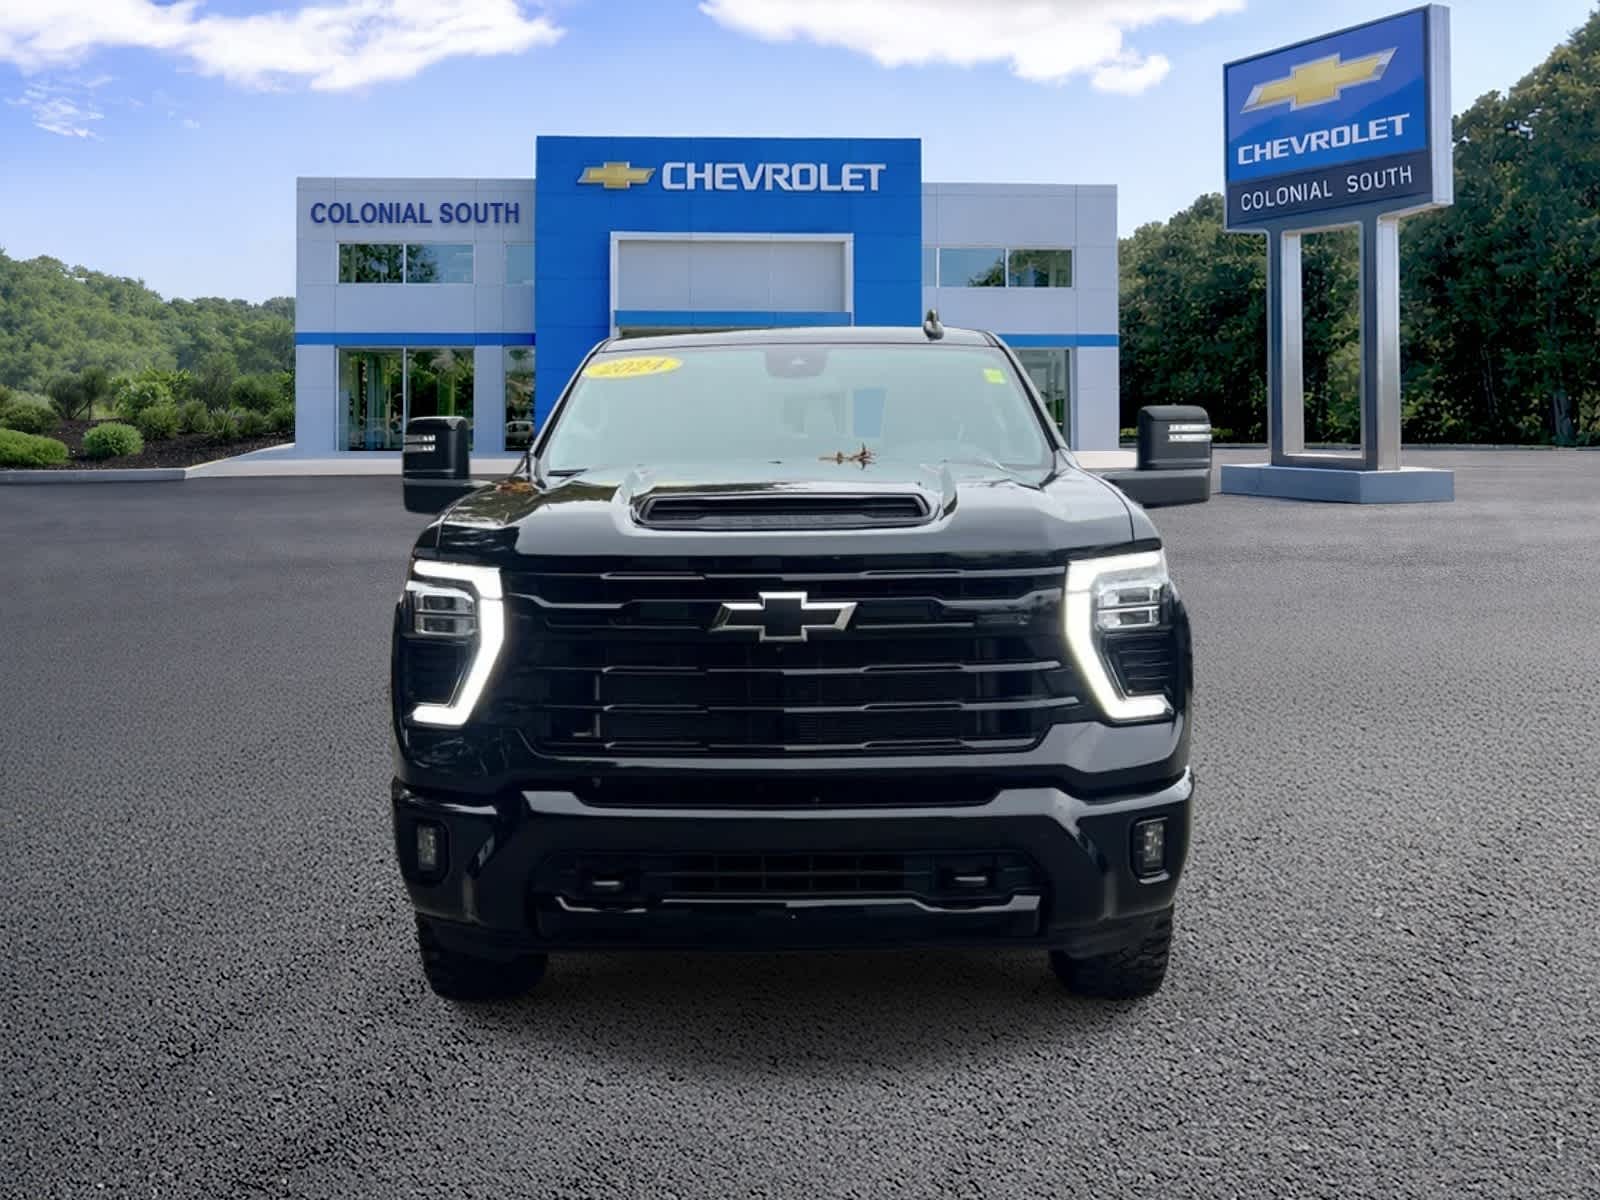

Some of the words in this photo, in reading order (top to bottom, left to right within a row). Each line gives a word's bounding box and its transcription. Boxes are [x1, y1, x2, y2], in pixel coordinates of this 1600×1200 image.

[1237, 113, 1410, 165] CHEVROLET
[662, 162, 887, 191] CHEVROLET
[1240, 179, 1332, 211] COLONIAL
[1346, 165, 1412, 193] SOUTH
[310, 202, 432, 224] COLONIAL
[439, 202, 520, 224] SOUTH
